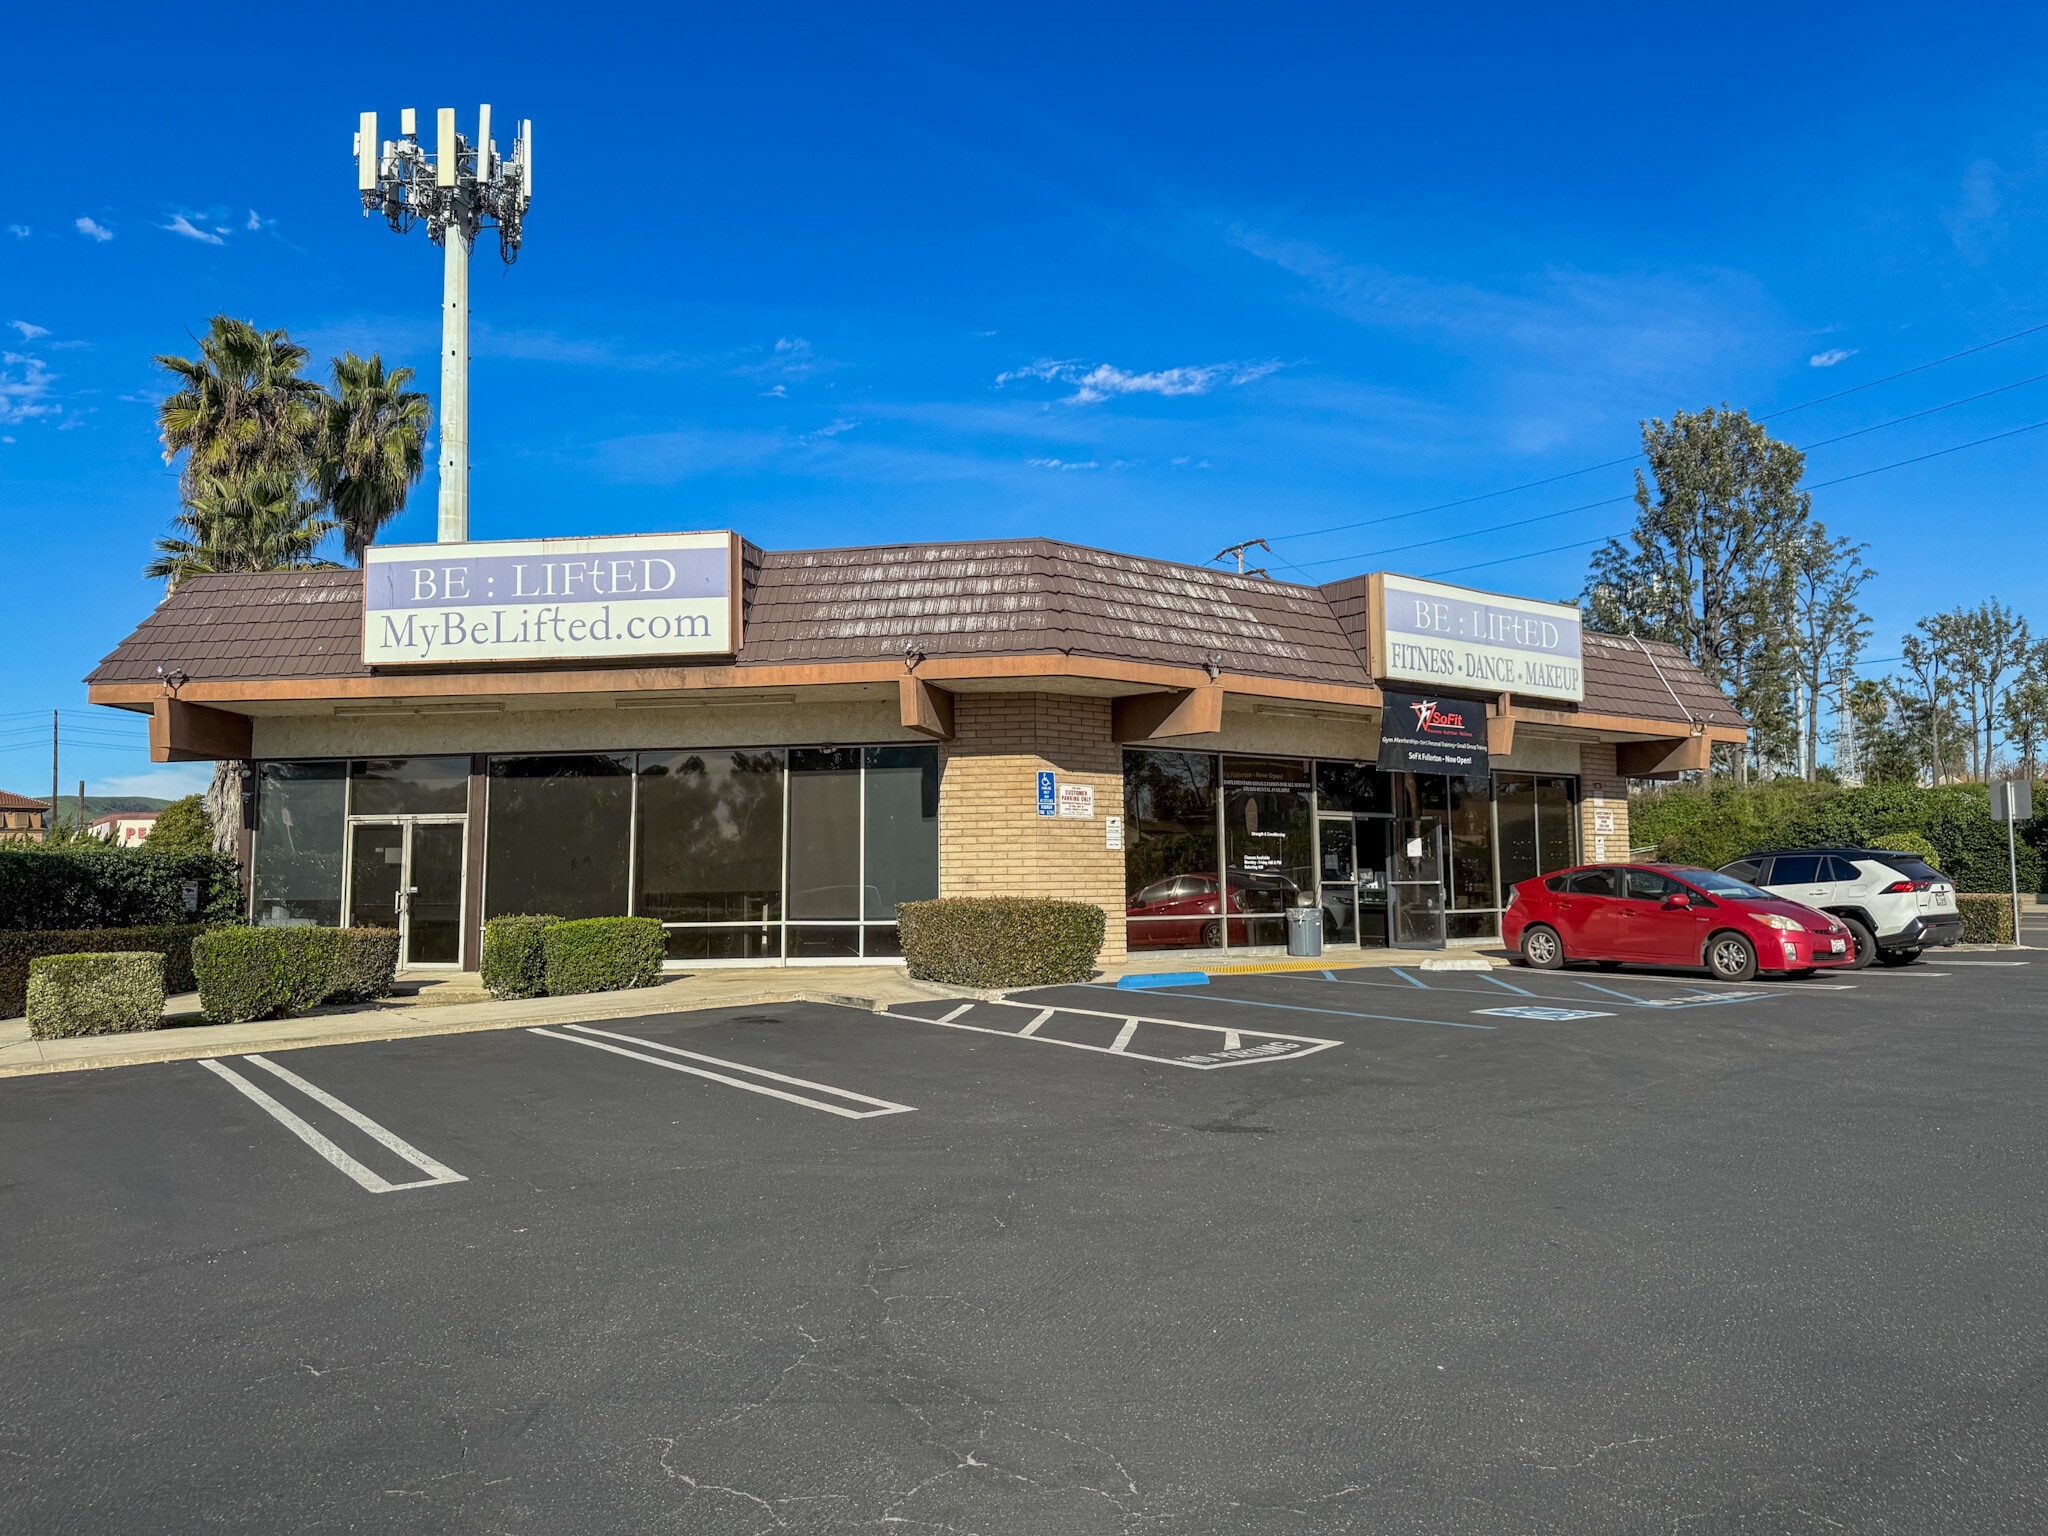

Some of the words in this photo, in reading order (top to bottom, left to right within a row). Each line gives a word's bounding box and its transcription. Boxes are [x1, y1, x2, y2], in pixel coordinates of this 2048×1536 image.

[410, 566, 471, 601] BE
[1413, 600, 1450, 633] BE
[379, 605, 712, 658] MyBeLifted.com
[1391, 642, 1454, 675] FITNESS
[1465, 652, 1515, 683] DANCE
[1525, 660, 1579, 692] MAKEUP
[1433, 711, 1463, 726] SoFit
[1382, 736, 1394, 744] Gym
[1408, 751, 1421, 760] SoFit
[1421, 752, 1443, 762] Fullerton
[1445, 755, 1457, 763] Now
[1456, 756, 1472, 765] Open!
[1208, 1041, 1300, 1060] PARKING
